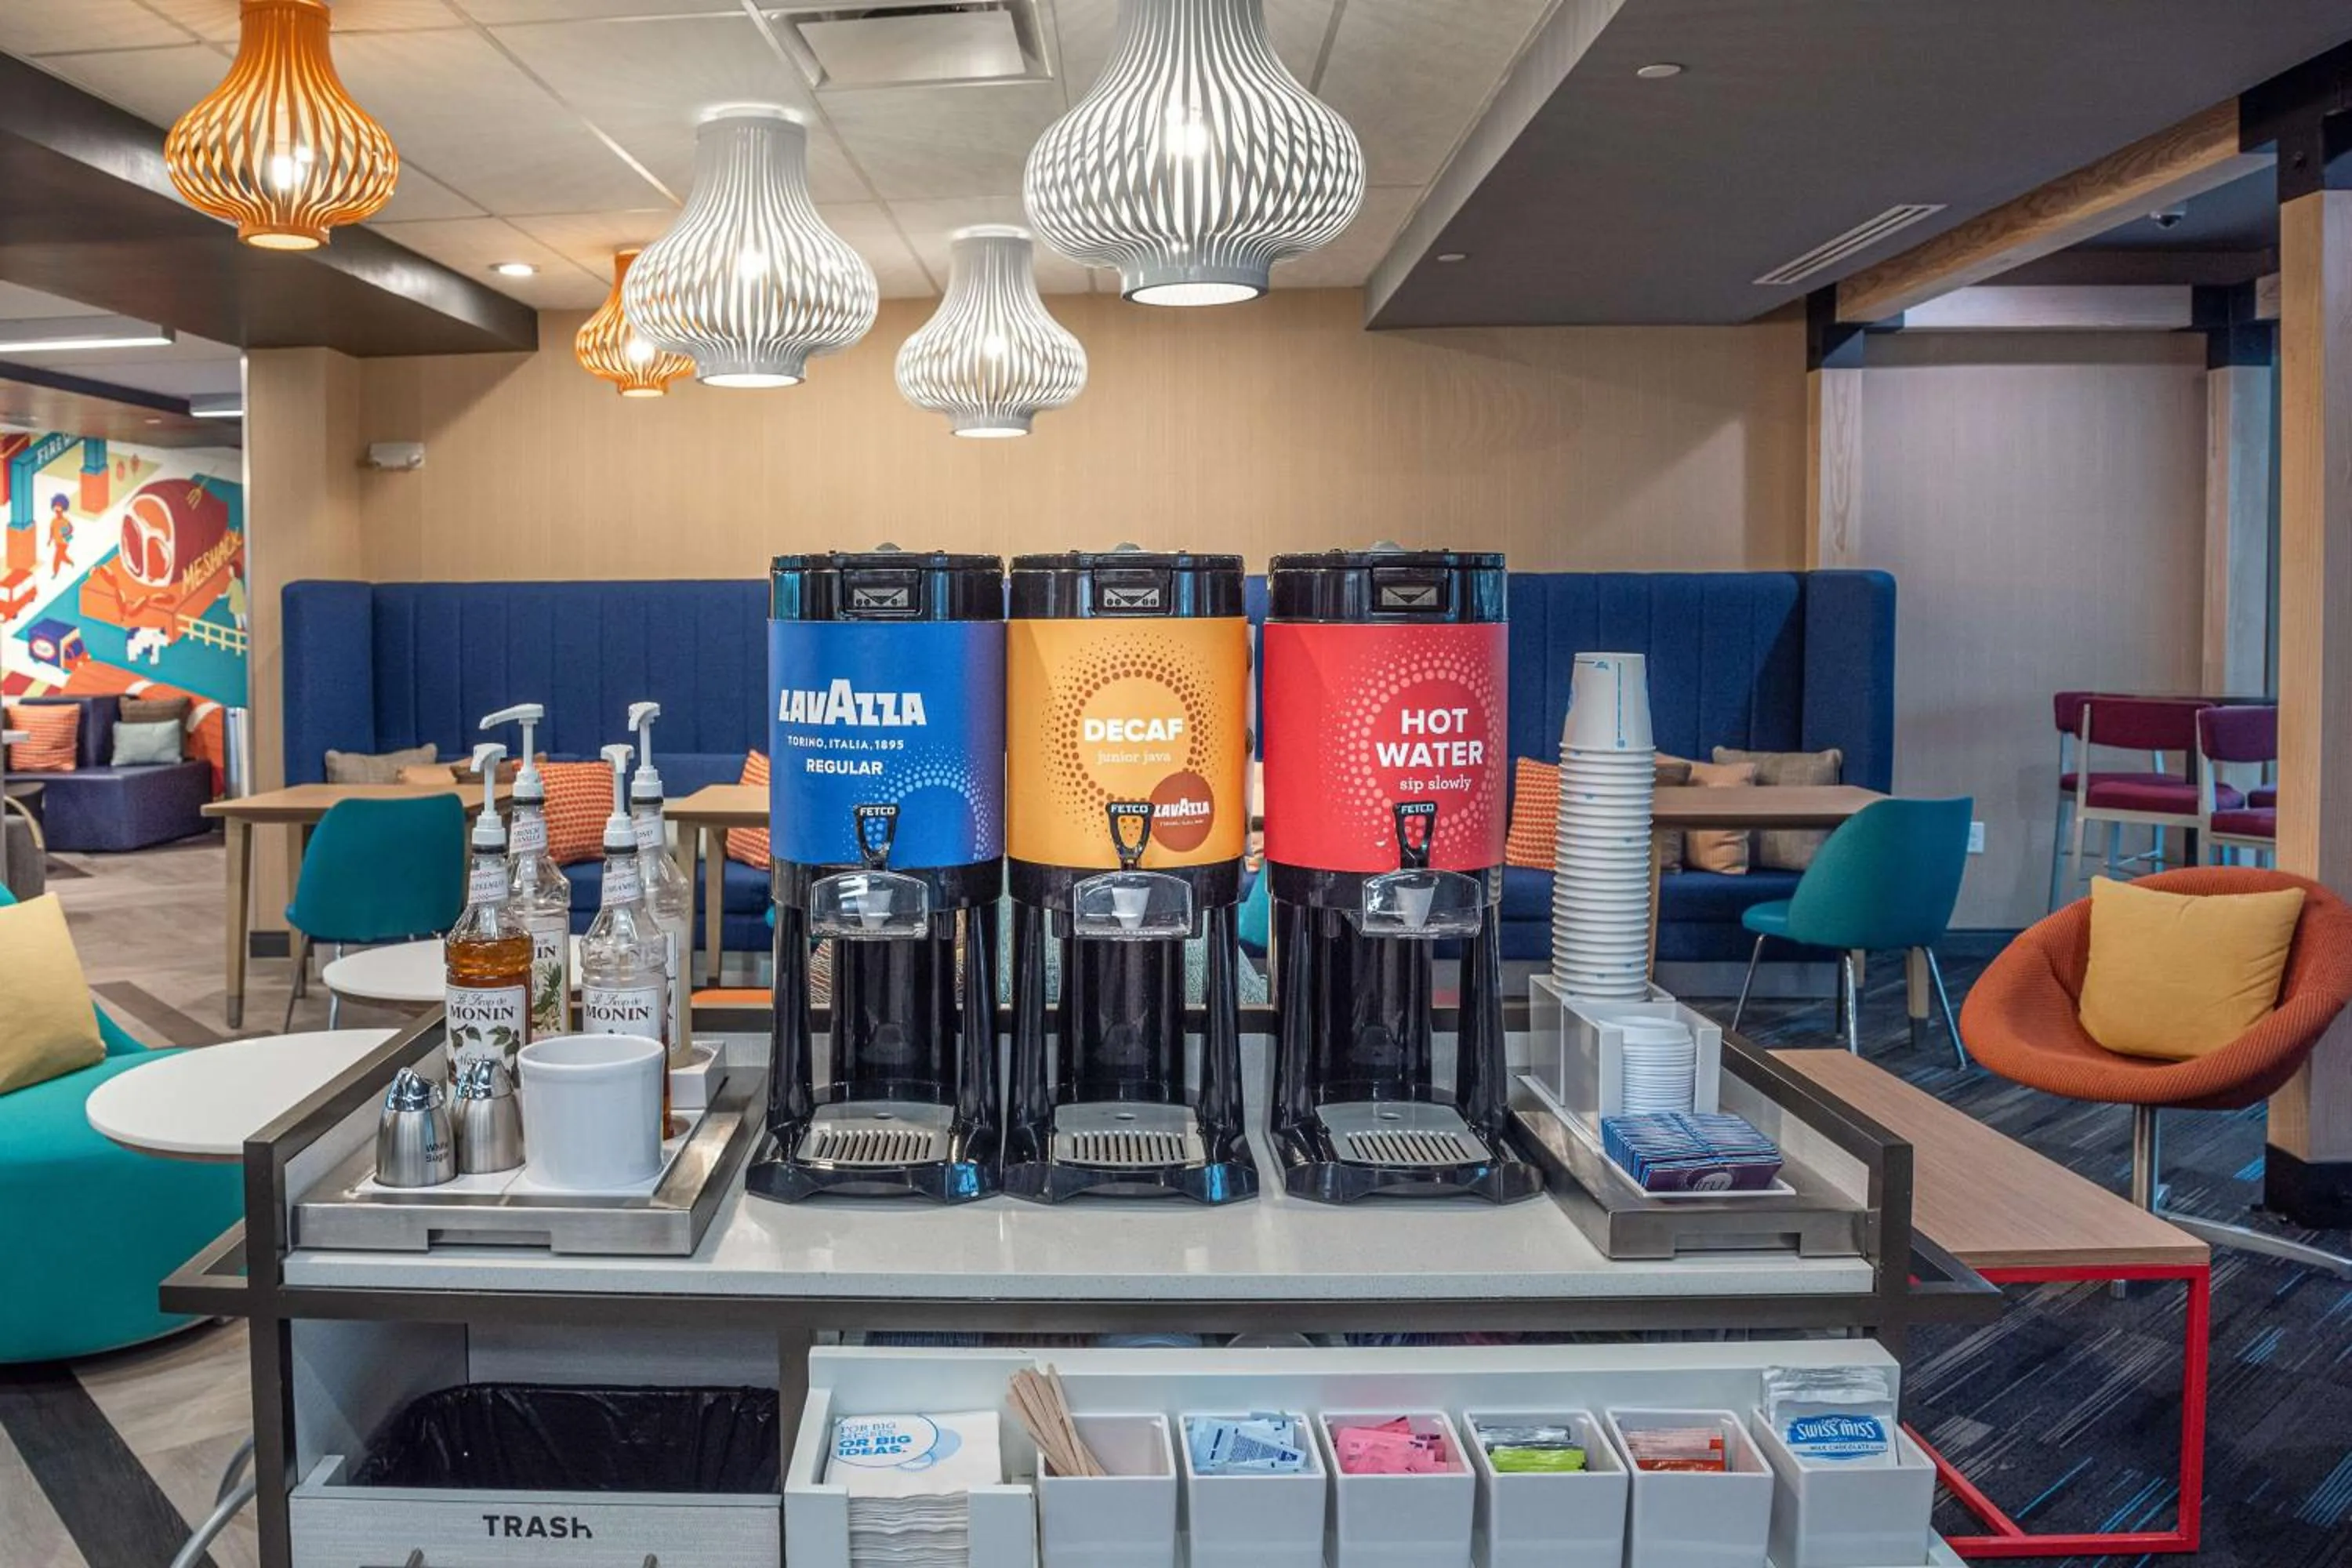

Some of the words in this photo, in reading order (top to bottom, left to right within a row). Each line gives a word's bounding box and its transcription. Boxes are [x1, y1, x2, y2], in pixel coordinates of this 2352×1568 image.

[779, 678, 927, 726] LAVAZZA
[1400, 709, 1468, 735] HOT
[1084, 719, 1183, 742] DECAF
[874, 739, 904, 750] 1895
[1096, 750, 1140, 765] junior
[1142, 750, 1171, 764] java
[1376, 741, 1484, 768] WATER
[806, 758, 883, 775] REGULAR
[1399, 777, 1425, 794] sip
[1428, 774, 1472, 791] slowly
[859, 806, 896, 817] FETCO
[1110, 804, 1149, 815] FETCO
[1400, 803, 1435, 814] FETCO
[450, 1004, 514, 1020] MONIN
[586, 1004, 649, 1021] MONIN
[839, 1446, 907, 1455] IDEAS.
